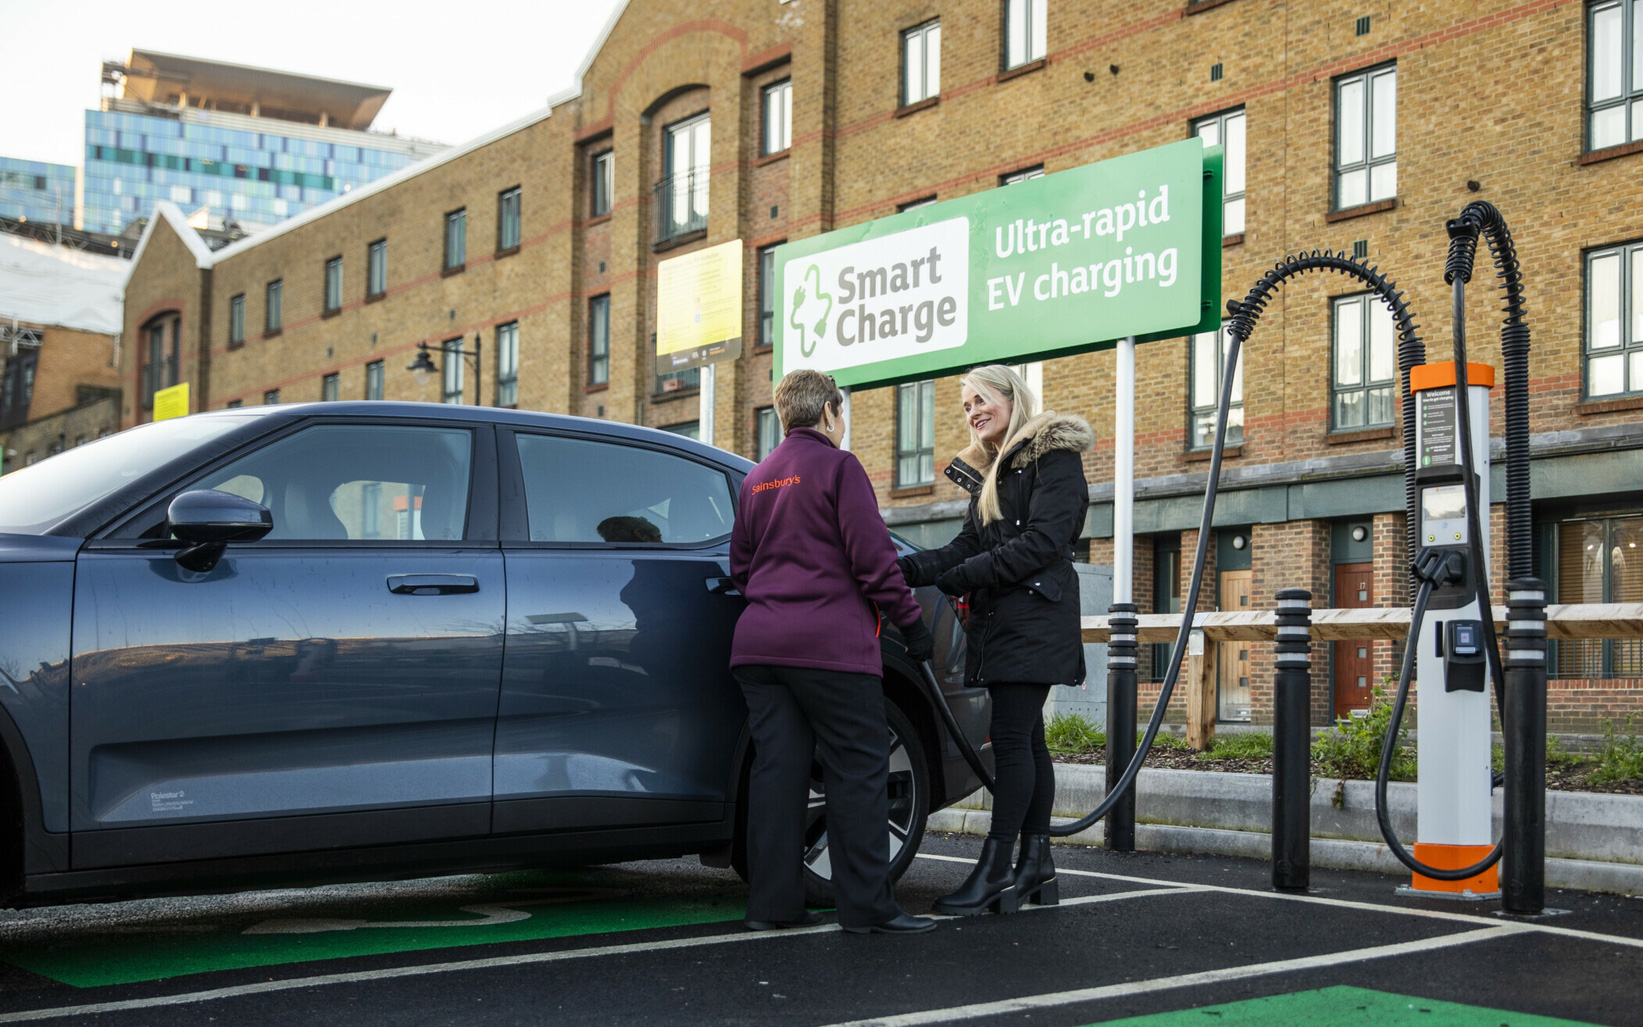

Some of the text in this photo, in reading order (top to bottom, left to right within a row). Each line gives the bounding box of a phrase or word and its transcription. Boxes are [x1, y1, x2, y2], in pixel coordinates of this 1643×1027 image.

[995, 184, 1171, 259] Ultra-rapid
[838, 245, 942, 305] Smart
[987, 246, 1178, 311] EV charging
[836, 295, 957, 347] Charge
[752, 475, 800, 495] Sainsbury's
[179, 790, 185, 798] 2
